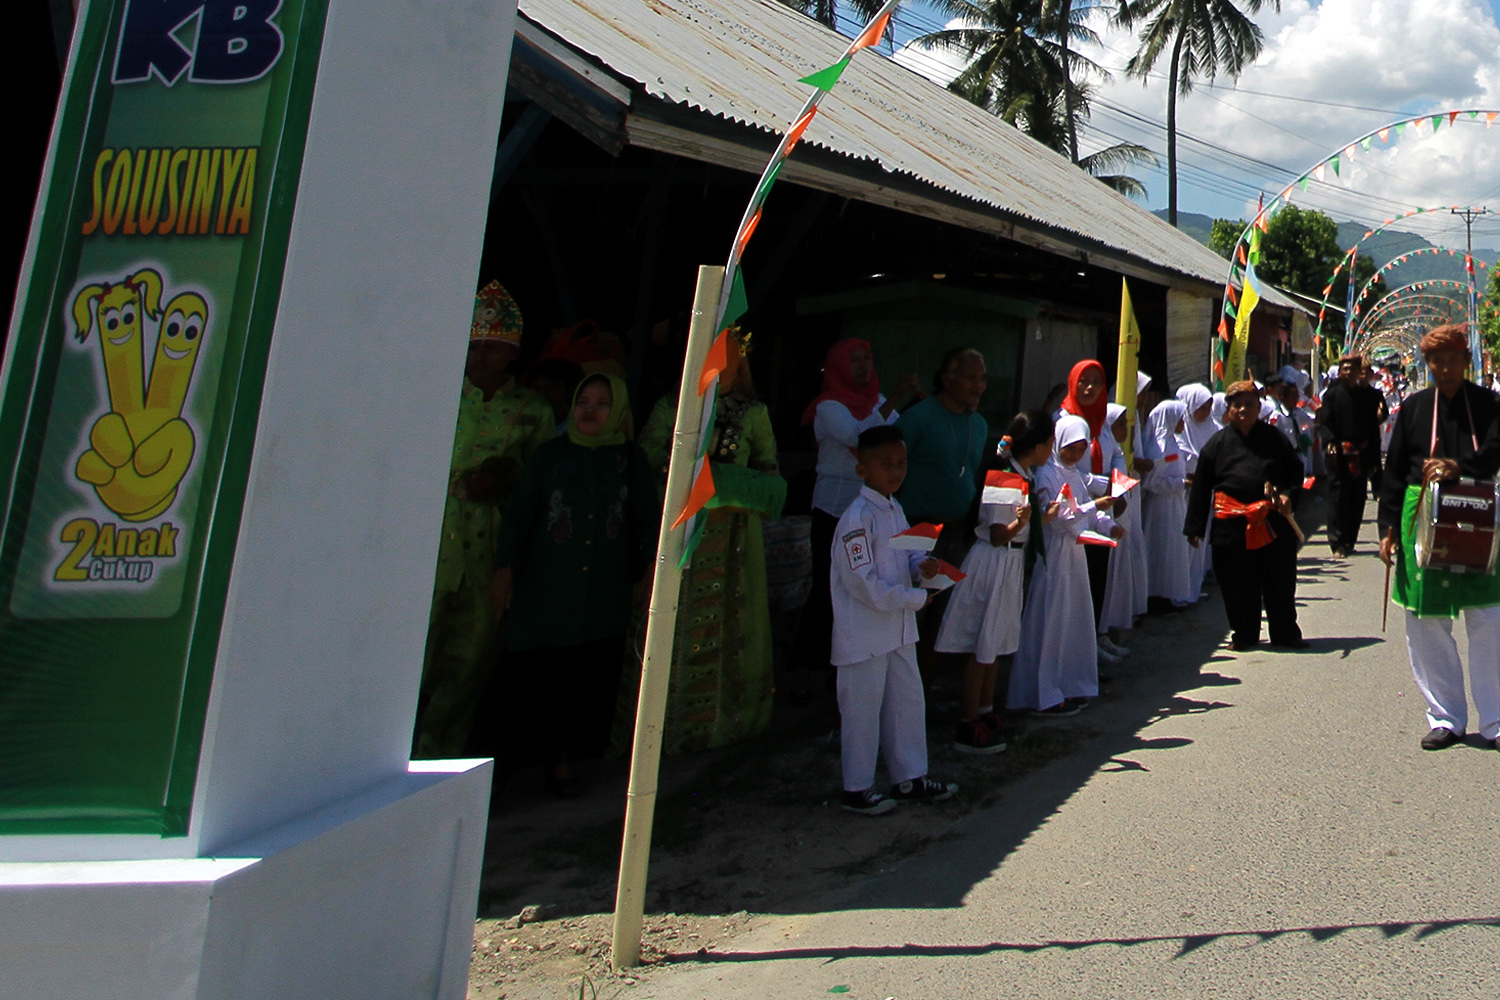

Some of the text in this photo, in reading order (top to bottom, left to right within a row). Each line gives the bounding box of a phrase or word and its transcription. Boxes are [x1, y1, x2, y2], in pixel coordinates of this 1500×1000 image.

[81, 147, 257, 236] SOLUSINYA
[54, 518, 180, 581] 2 Anak
[88, 557, 153, 583] Cukup
